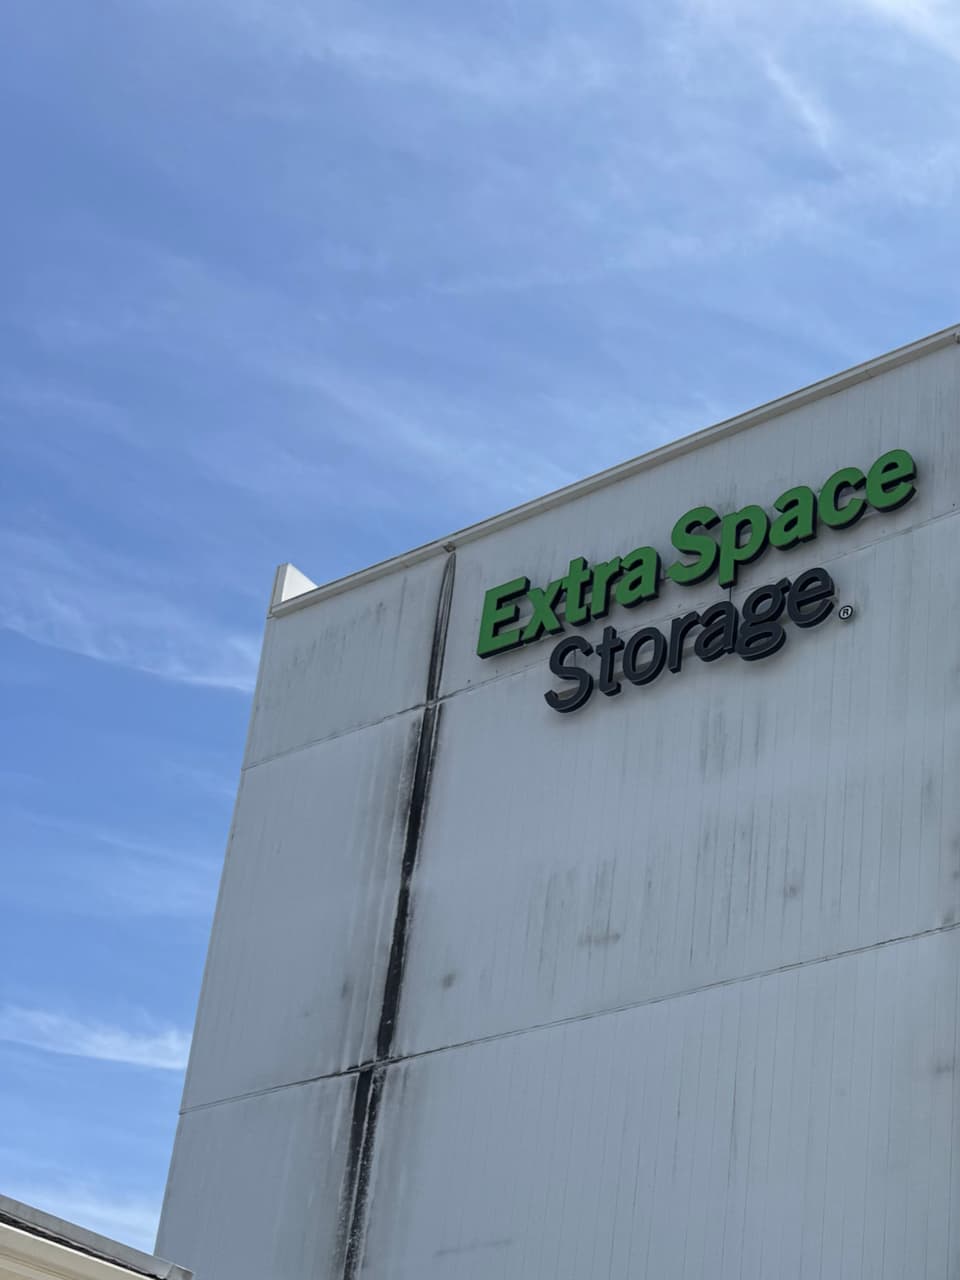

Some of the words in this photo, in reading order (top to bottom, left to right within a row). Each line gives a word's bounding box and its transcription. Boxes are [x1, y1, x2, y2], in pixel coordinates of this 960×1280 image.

[477, 546, 661, 659] Extra
[667, 448, 918, 588] Space
[544, 567, 836, 713] Storage
